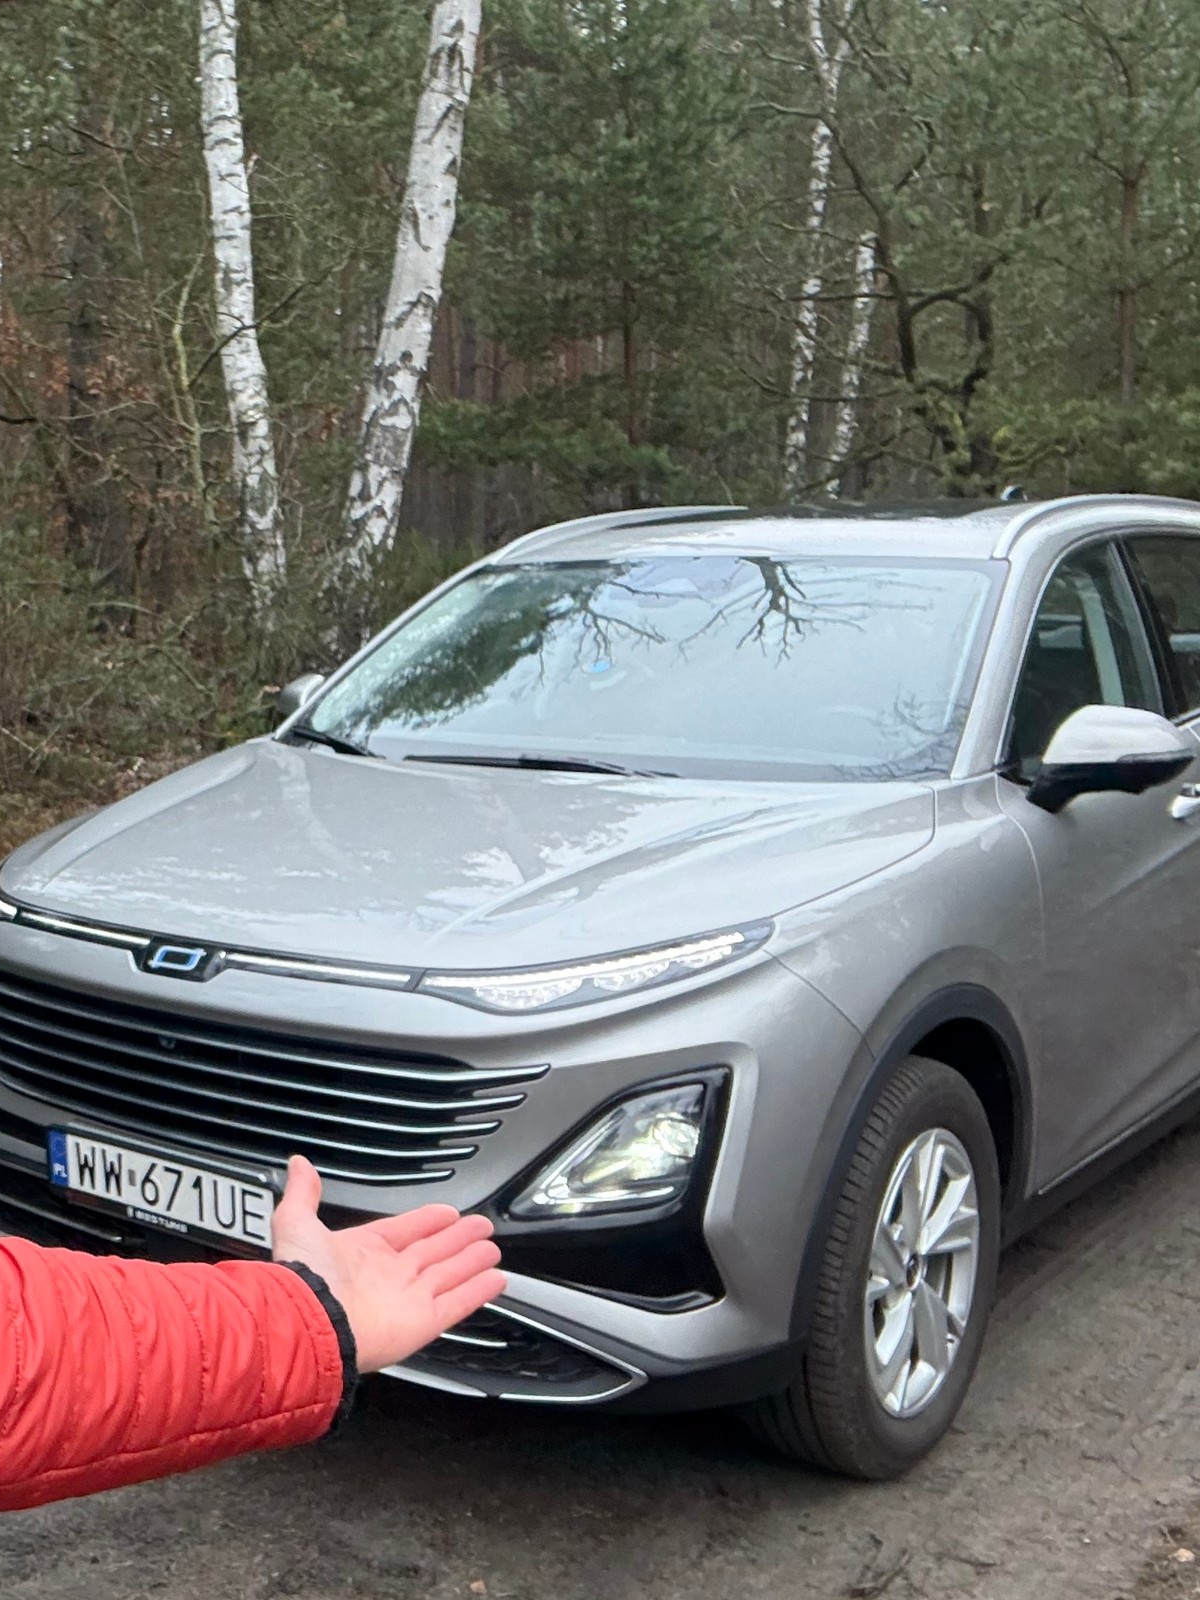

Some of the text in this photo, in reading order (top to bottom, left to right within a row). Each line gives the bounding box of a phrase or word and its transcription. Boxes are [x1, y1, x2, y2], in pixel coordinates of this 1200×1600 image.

[52, 1163, 67, 1178] PL
[75, 1141, 266, 1241] WW 671UE
